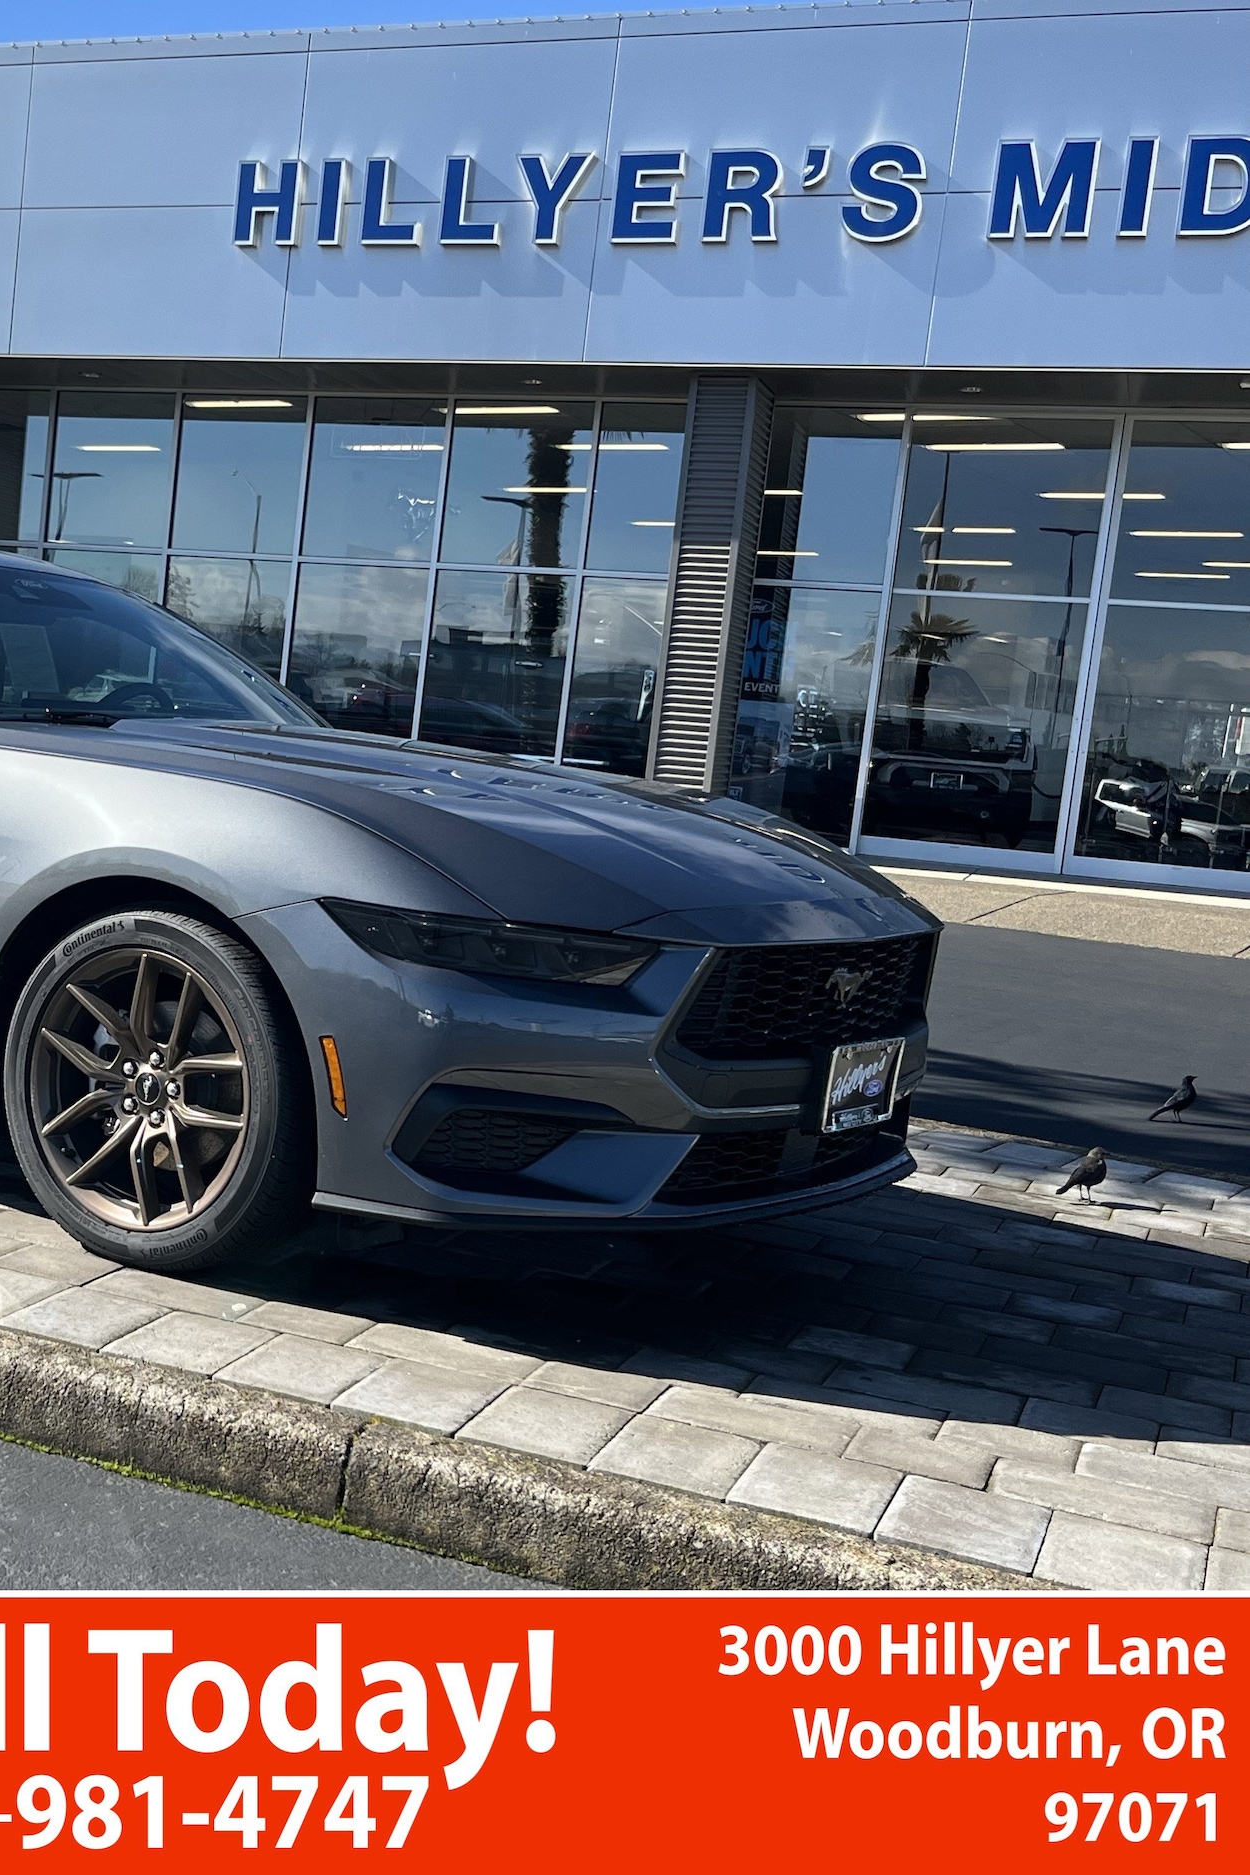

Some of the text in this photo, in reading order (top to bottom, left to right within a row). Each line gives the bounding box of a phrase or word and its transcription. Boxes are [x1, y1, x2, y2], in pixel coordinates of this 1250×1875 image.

[987, 136, 1250, 239] MID
[743, 681, 781, 694] EVENT
[62, 921, 117, 957] Continental
[149, 1228, 208, 1259] Continental
